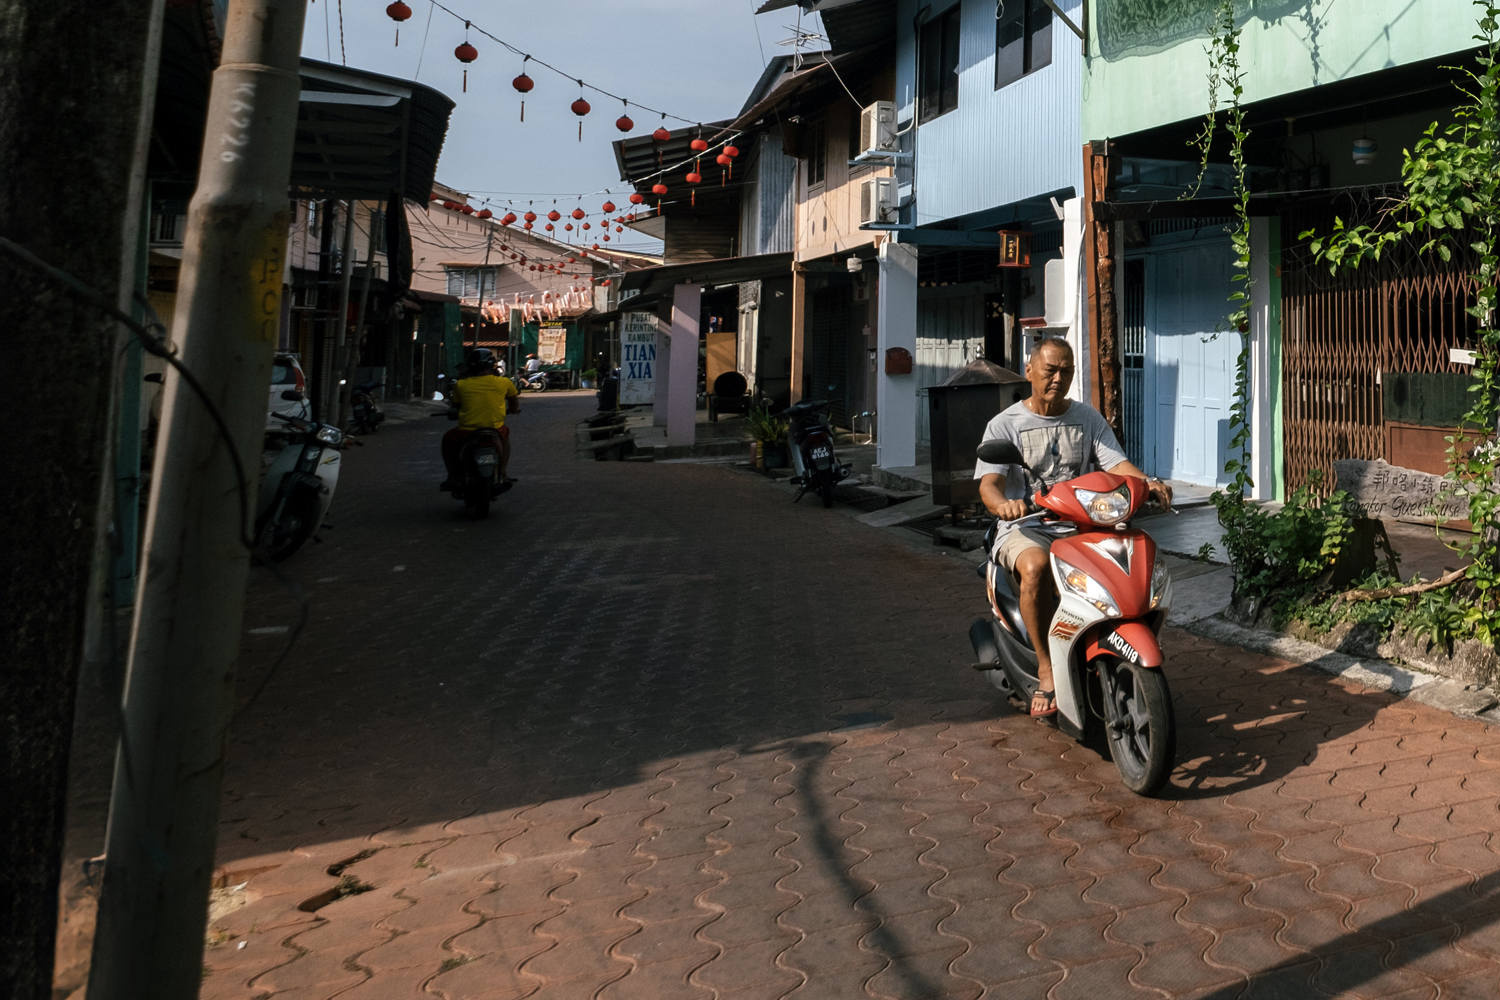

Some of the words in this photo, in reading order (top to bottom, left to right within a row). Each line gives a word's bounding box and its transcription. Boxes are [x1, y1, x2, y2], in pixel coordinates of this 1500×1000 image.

[632, 313, 651, 322] PUSAT
[628, 333, 654, 343] RAMBUT
[625, 344, 656, 361] TIAN
[628, 362, 652, 379] XIA
[1061, 608, 1085, 623] HONDA
